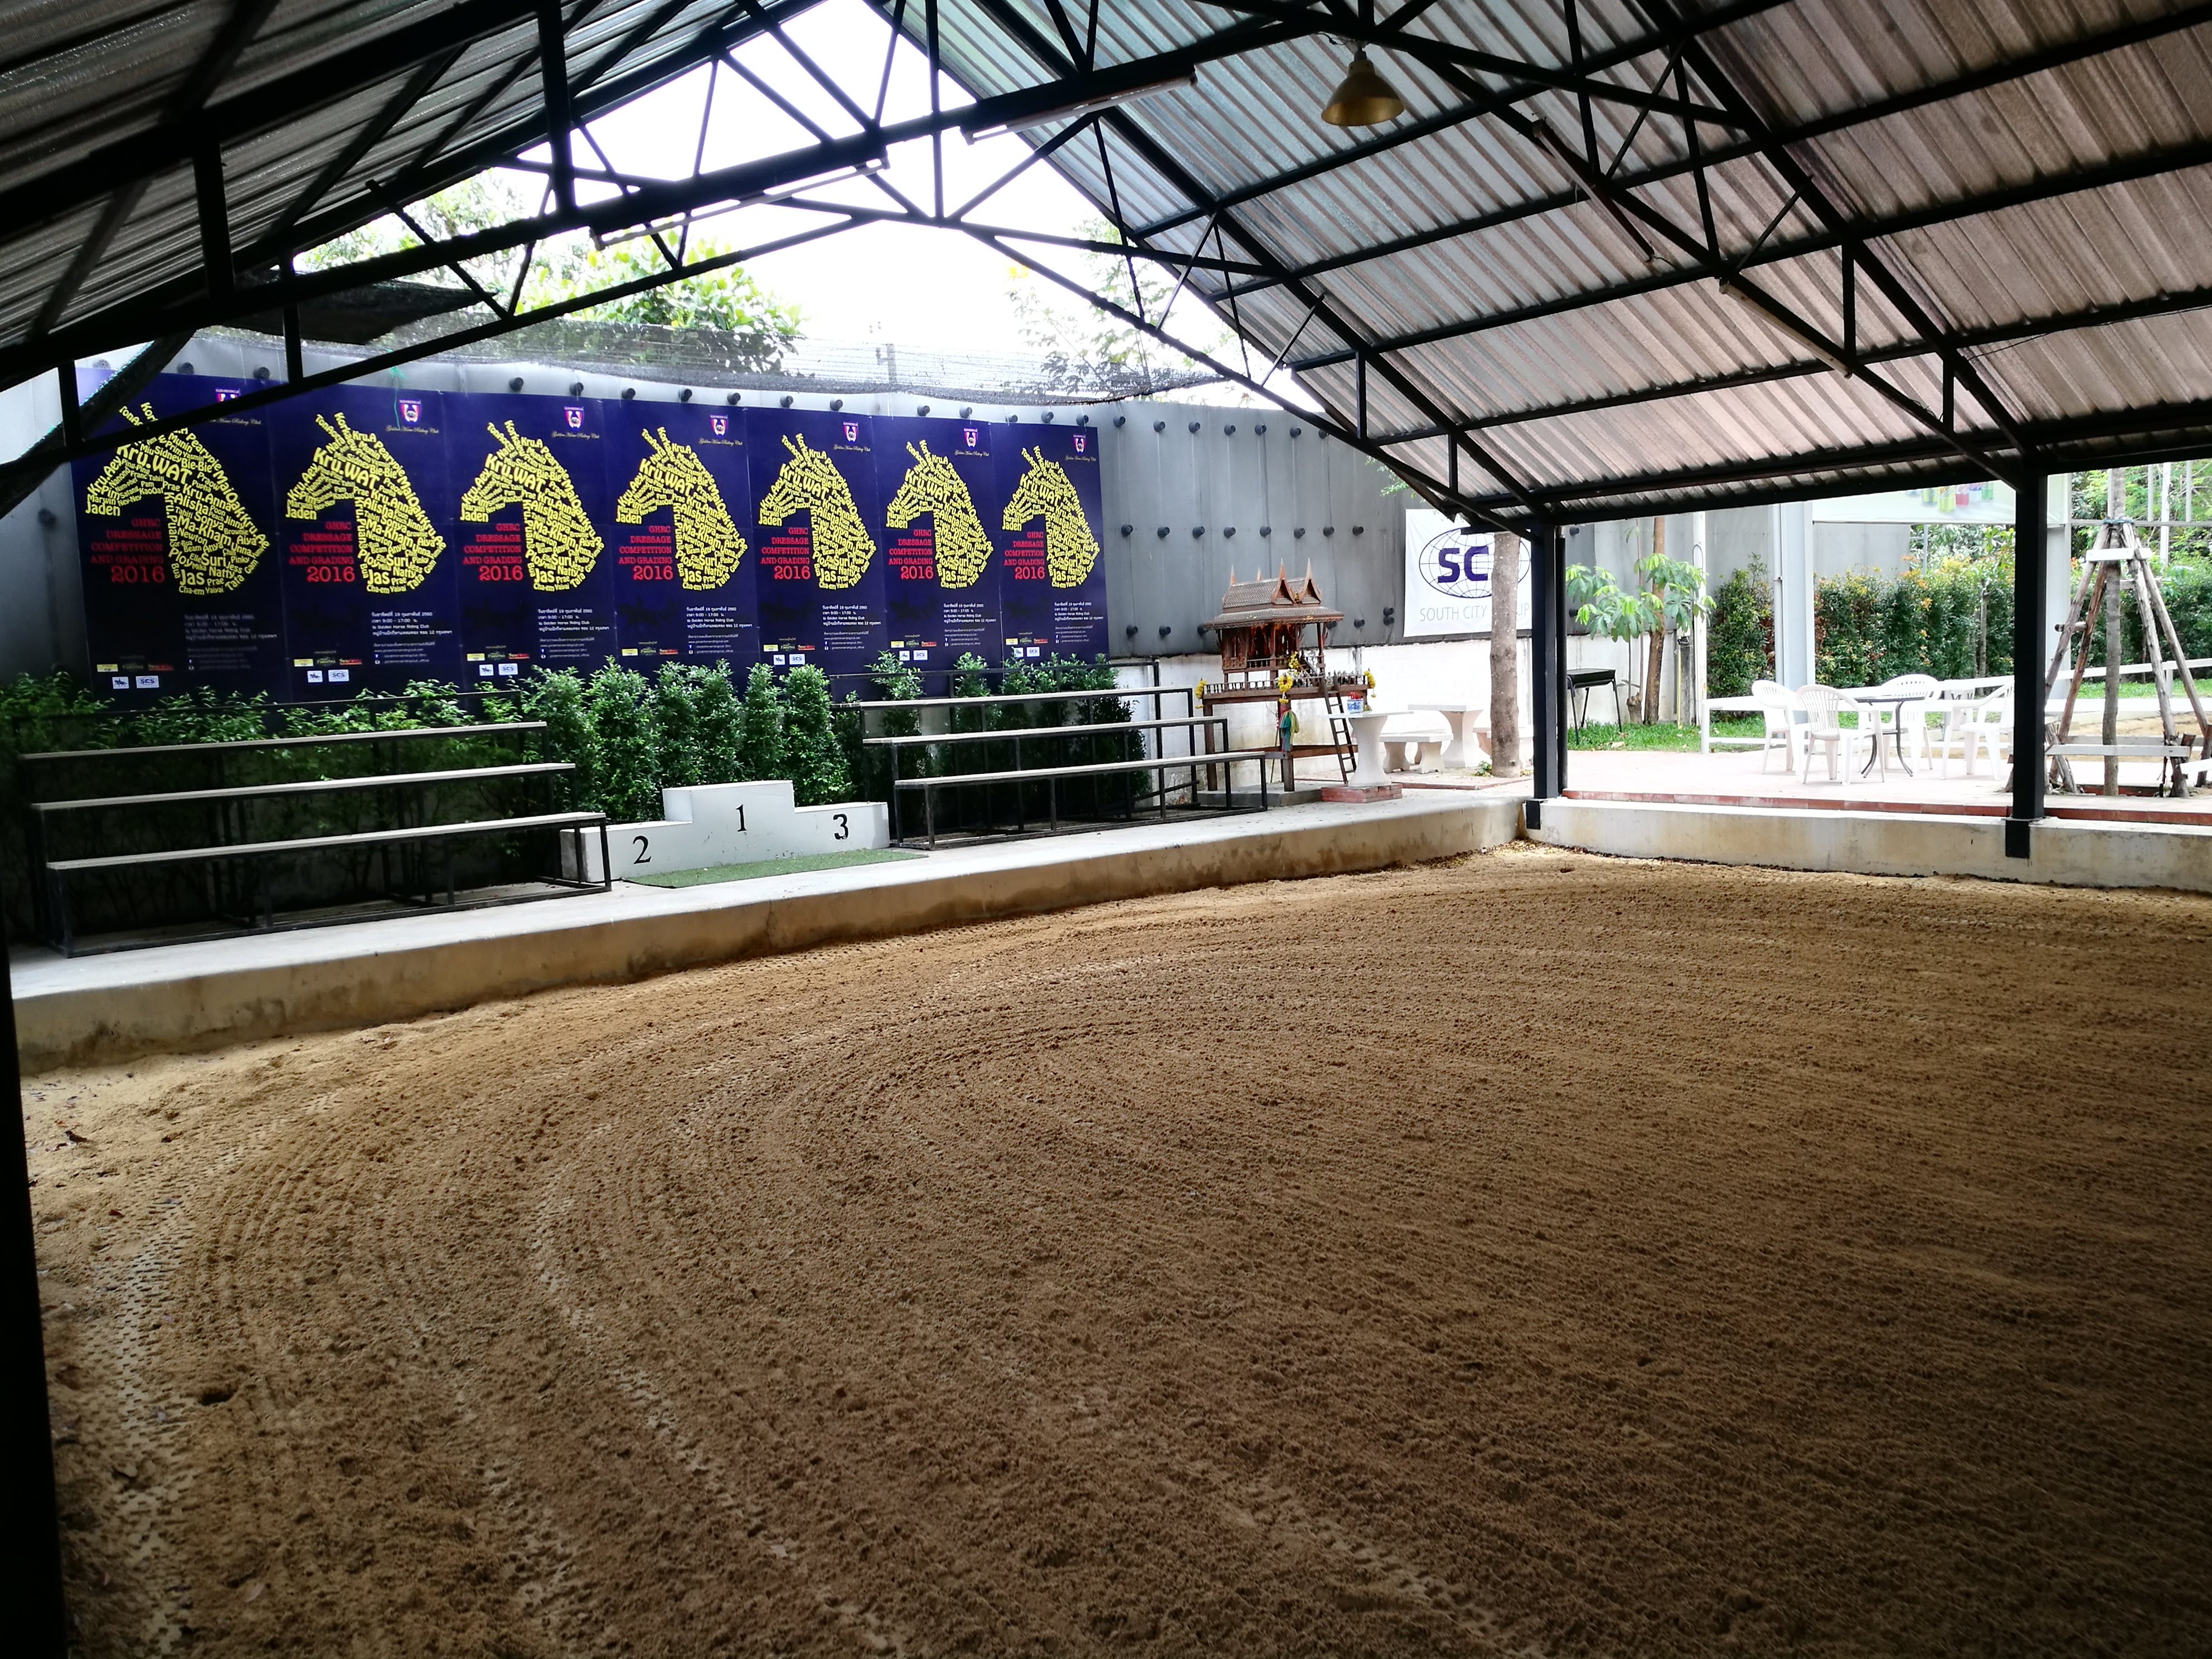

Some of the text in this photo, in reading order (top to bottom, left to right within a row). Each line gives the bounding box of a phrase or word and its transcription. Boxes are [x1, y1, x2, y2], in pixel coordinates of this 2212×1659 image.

[140, 444, 154, 455] Miu
[166, 441, 182, 456] Prim
[168, 433, 192, 453] Munin
[154, 446, 182, 462] Sidney
[117, 444, 192, 485] Kru.WAT
[182, 458, 212, 473] Bie-Bie
[313, 447, 380, 490] Kru.WAT
[87, 456, 122, 496] Kru.Aey
[485, 453, 545, 493] Kru.WAT
[639, 458, 693, 497] Kru.WAT
[163, 481, 180, 492] Prae
[779, 463, 828, 501] Kru.WAT
[905, 468, 950, 504] Kru.WAT
[101, 486, 120, 500] Pim
[183, 483, 231, 512] Kru.Anna
[1020, 473, 1061, 507] Kru.WAT
[88, 494, 115, 505] Marwin
[174, 493, 208, 515] Alisha
[85, 500, 120, 516] Jaden
[285, 505, 316, 520] Jaden
[460, 508, 488, 522] Jaden
[194, 511, 224, 530] Sonya
[224, 516, 245, 529] Jinny
[617, 510, 642, 524] Jaden
[759, 513, 782, 526] Jaden
[887, 516, 908, 528] Jaden
[177, 515, 231, 546] Ma-Kham
[1003, 519, 1022, 531] Jaden
[177, 527, 207, 545] Newton
[236, 535, 256, 546] Aiya
[203, 542, 223, 554] Anya
[231, 542, 252, 556] Unna
[289, 544, 353, 552] COMPETITION
[168, 547, 193, 567] Ploy
[201, 552, 226, 567] Suri
[386, 553, 408, 567] Suri
[551, 553, 571, 566] Suri
[699, 554, 717, 566] Suri
[833, 555, 850, 566] Suri
[1438, 545, 1490, 583] SC
[109, 565, 165, 582] 2016
[172, 563, 181, 579] Bua
[209, 566, 235, 579] Natty
[226, 562, 242, 574] Jess
[306, 566, 355, 581] 2016
[478, 565, 523, 580] 2016
[633, 565, 673, 579] 2016
[774, 565, 810, 579] 2016
[819, 569, 836, 582] Jas
[900, 566, 933, 579] 2016
[941, 569, 956, 581] Jas
[1015, 566, 1045, 579] 2016
[1052, 569, 1066, 581] Jas
[180, 569, 205, 586] Jas
[225, 575, 244, 590] Tata
[368, 569, 390, 585] Jas
[535, 569, 554, 583] Jas
[683, 569, 701, 583] Jas
[1420, 605, 1487, 622] SOUTH CITY
[735, 804, 747, 832] 1
[833, 813, 849, 840] 3
[633, 835, 651, 865] 2
